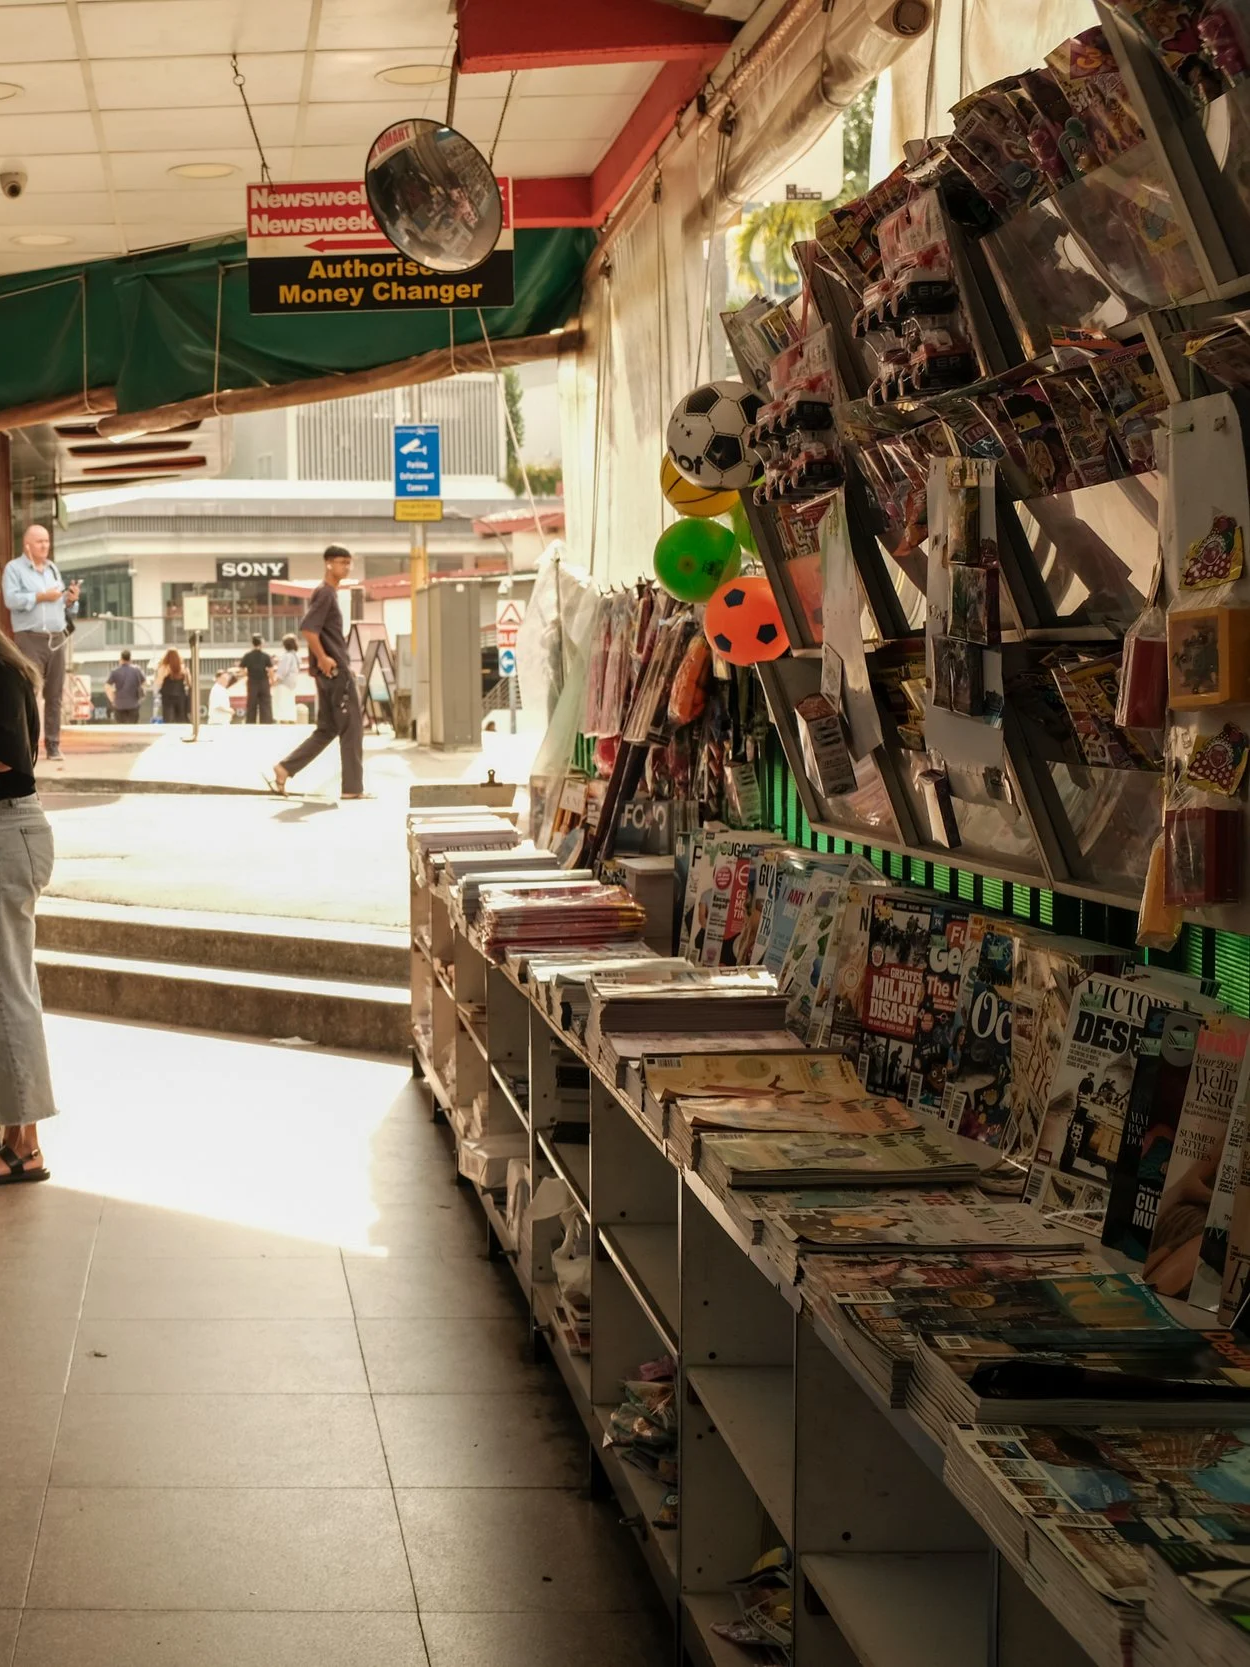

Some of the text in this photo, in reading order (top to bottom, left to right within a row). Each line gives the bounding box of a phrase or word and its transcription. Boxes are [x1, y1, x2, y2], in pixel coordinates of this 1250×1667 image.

[251, 210, 376, 235] Newsweek
[279, 283, 483, 306] Money Changer
[406, 460, 428, 470] Parking
[406, 483, 429, 492] Camera
[221, 562, 284, 577] SONY
[927, 976, 950, 999] The
[869, 997, 918, 1027] DISAST
[1178, 1128, 1217, 1146] SUMMER
[1181, 1139, 1208, 1152] STYLE
[1174, 1145, 1212, 1163] UPDATES
